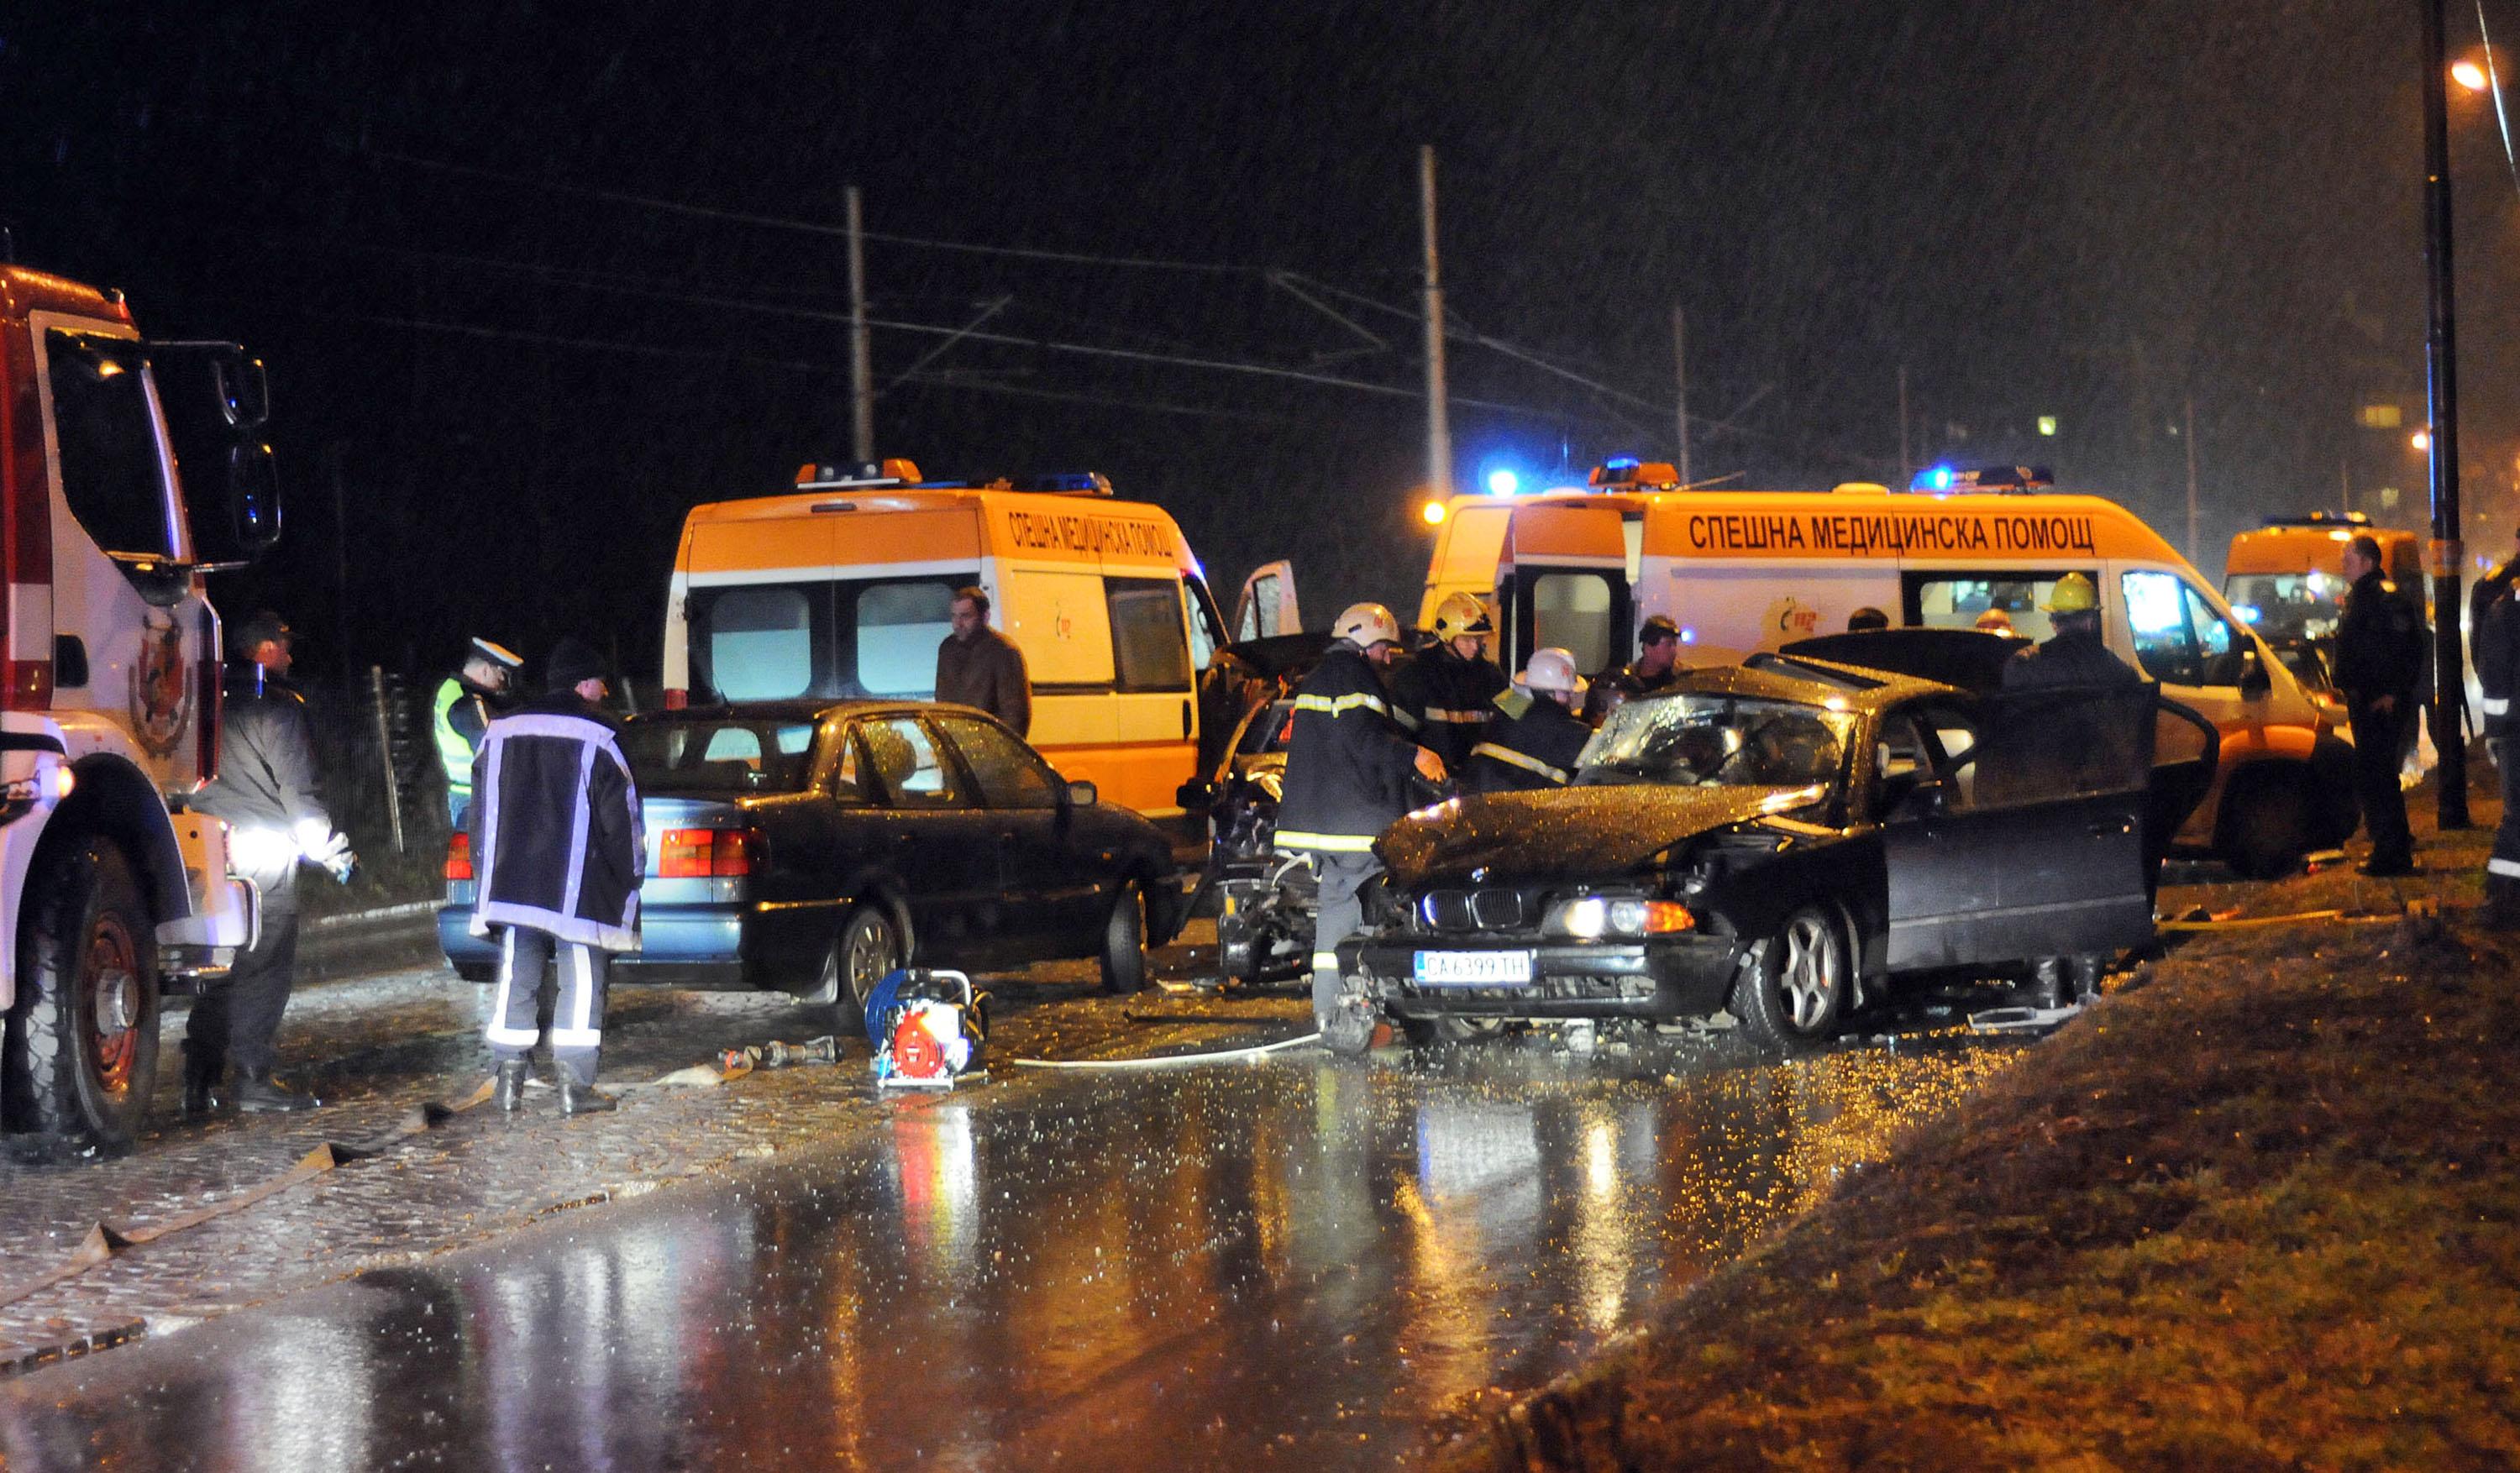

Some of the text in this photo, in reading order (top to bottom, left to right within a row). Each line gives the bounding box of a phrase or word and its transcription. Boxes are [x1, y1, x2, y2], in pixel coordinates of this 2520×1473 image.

[1009, 512, 1174, 563] СПЕШНА МЕДИЦИНСКА ПОМОЩ
[1689, 516, 2095, 555] СПЕШНА МЕДИЦИНСКА ПОМОЩ
[1453, 957, 1495, 976] 6399
